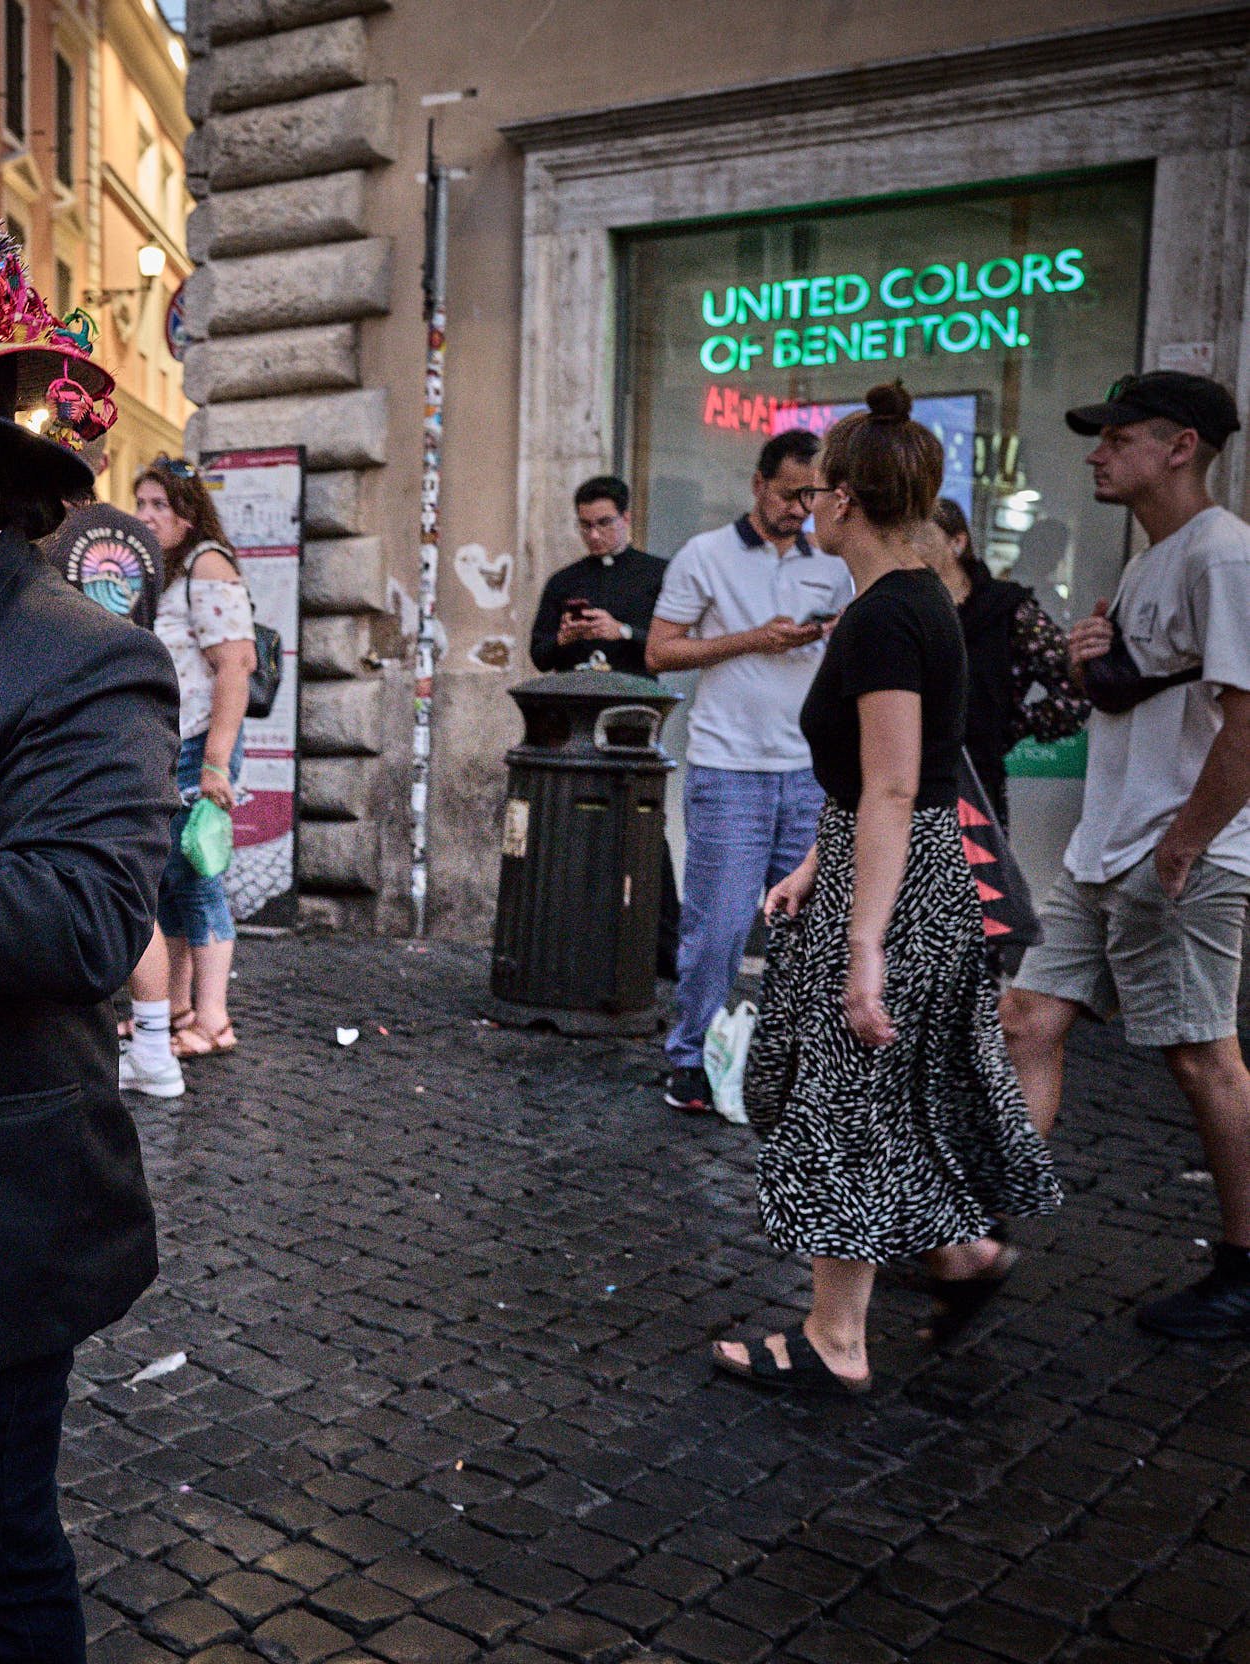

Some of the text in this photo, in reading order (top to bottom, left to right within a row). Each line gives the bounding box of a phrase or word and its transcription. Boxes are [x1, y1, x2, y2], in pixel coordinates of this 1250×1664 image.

[702, 248, 1085, 327] UNITED COLORS
[700, 306, 1031, 375] OF BENETTON.
